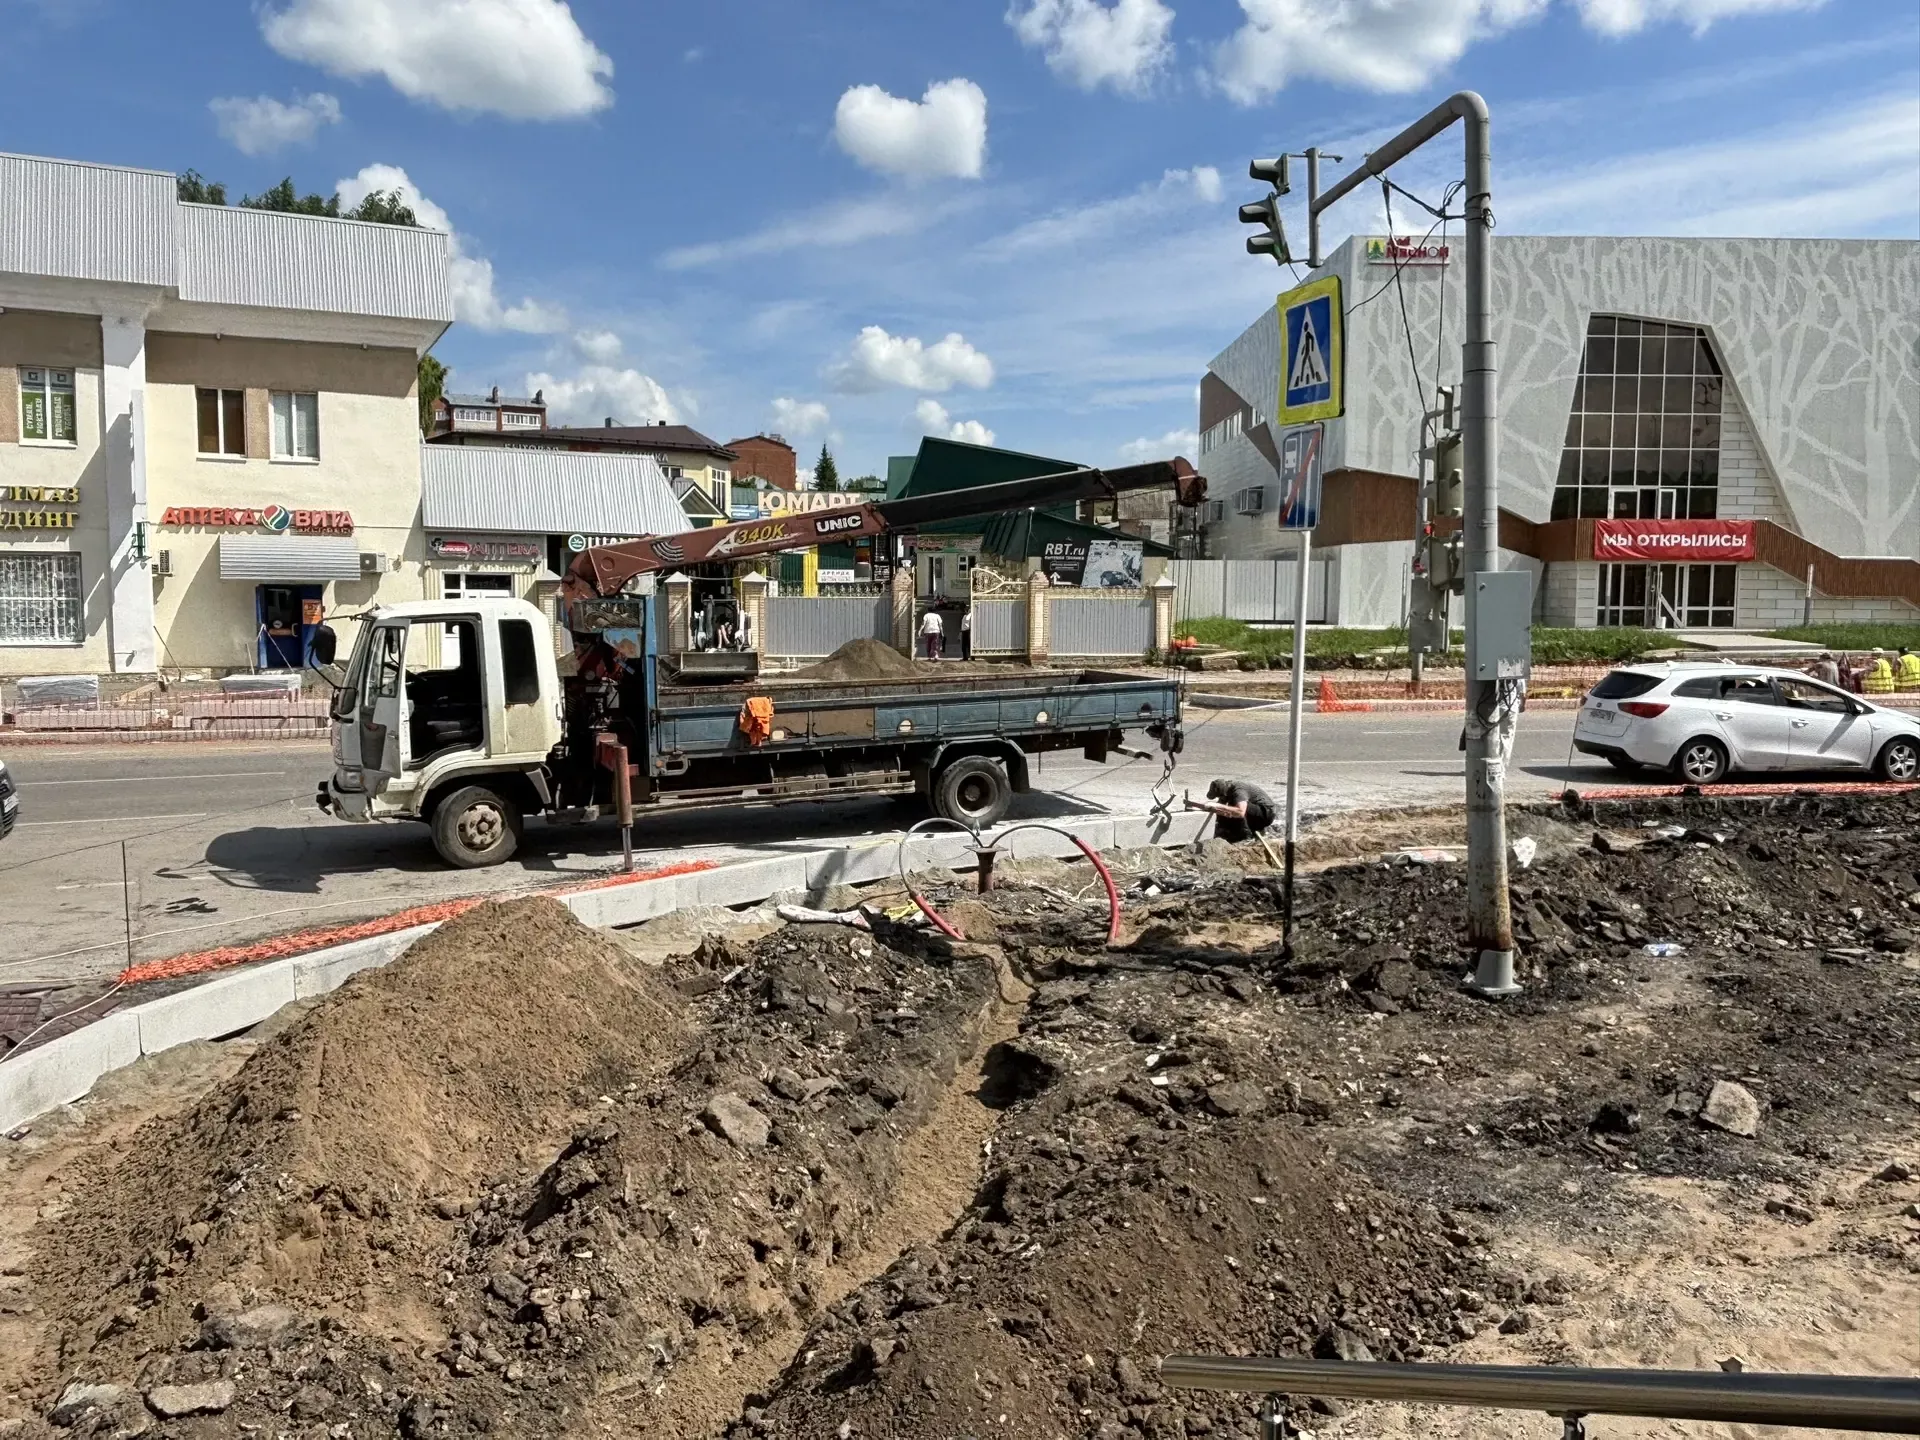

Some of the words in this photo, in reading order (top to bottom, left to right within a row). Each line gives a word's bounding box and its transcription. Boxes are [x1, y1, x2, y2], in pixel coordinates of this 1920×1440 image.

[757, 491, 861, 513] ЮМАРТ
[0, 510, 79, 531] ДИНГ
[161, 506, 258, 525] АПТЕКА
[294, 509, 354, 528] ВИТА
[816, 515, 862, 532] UNIC
[737, 523, 786, 544] 340K
[1603, 533, 1632, 546] МЫ
[1637, 533, 1746, 546] ОТКРЫЛИСЬ!
[471, 542, 541, 555] АПТЕКА
[1044, 543, 1085, 555] RBT.ru
